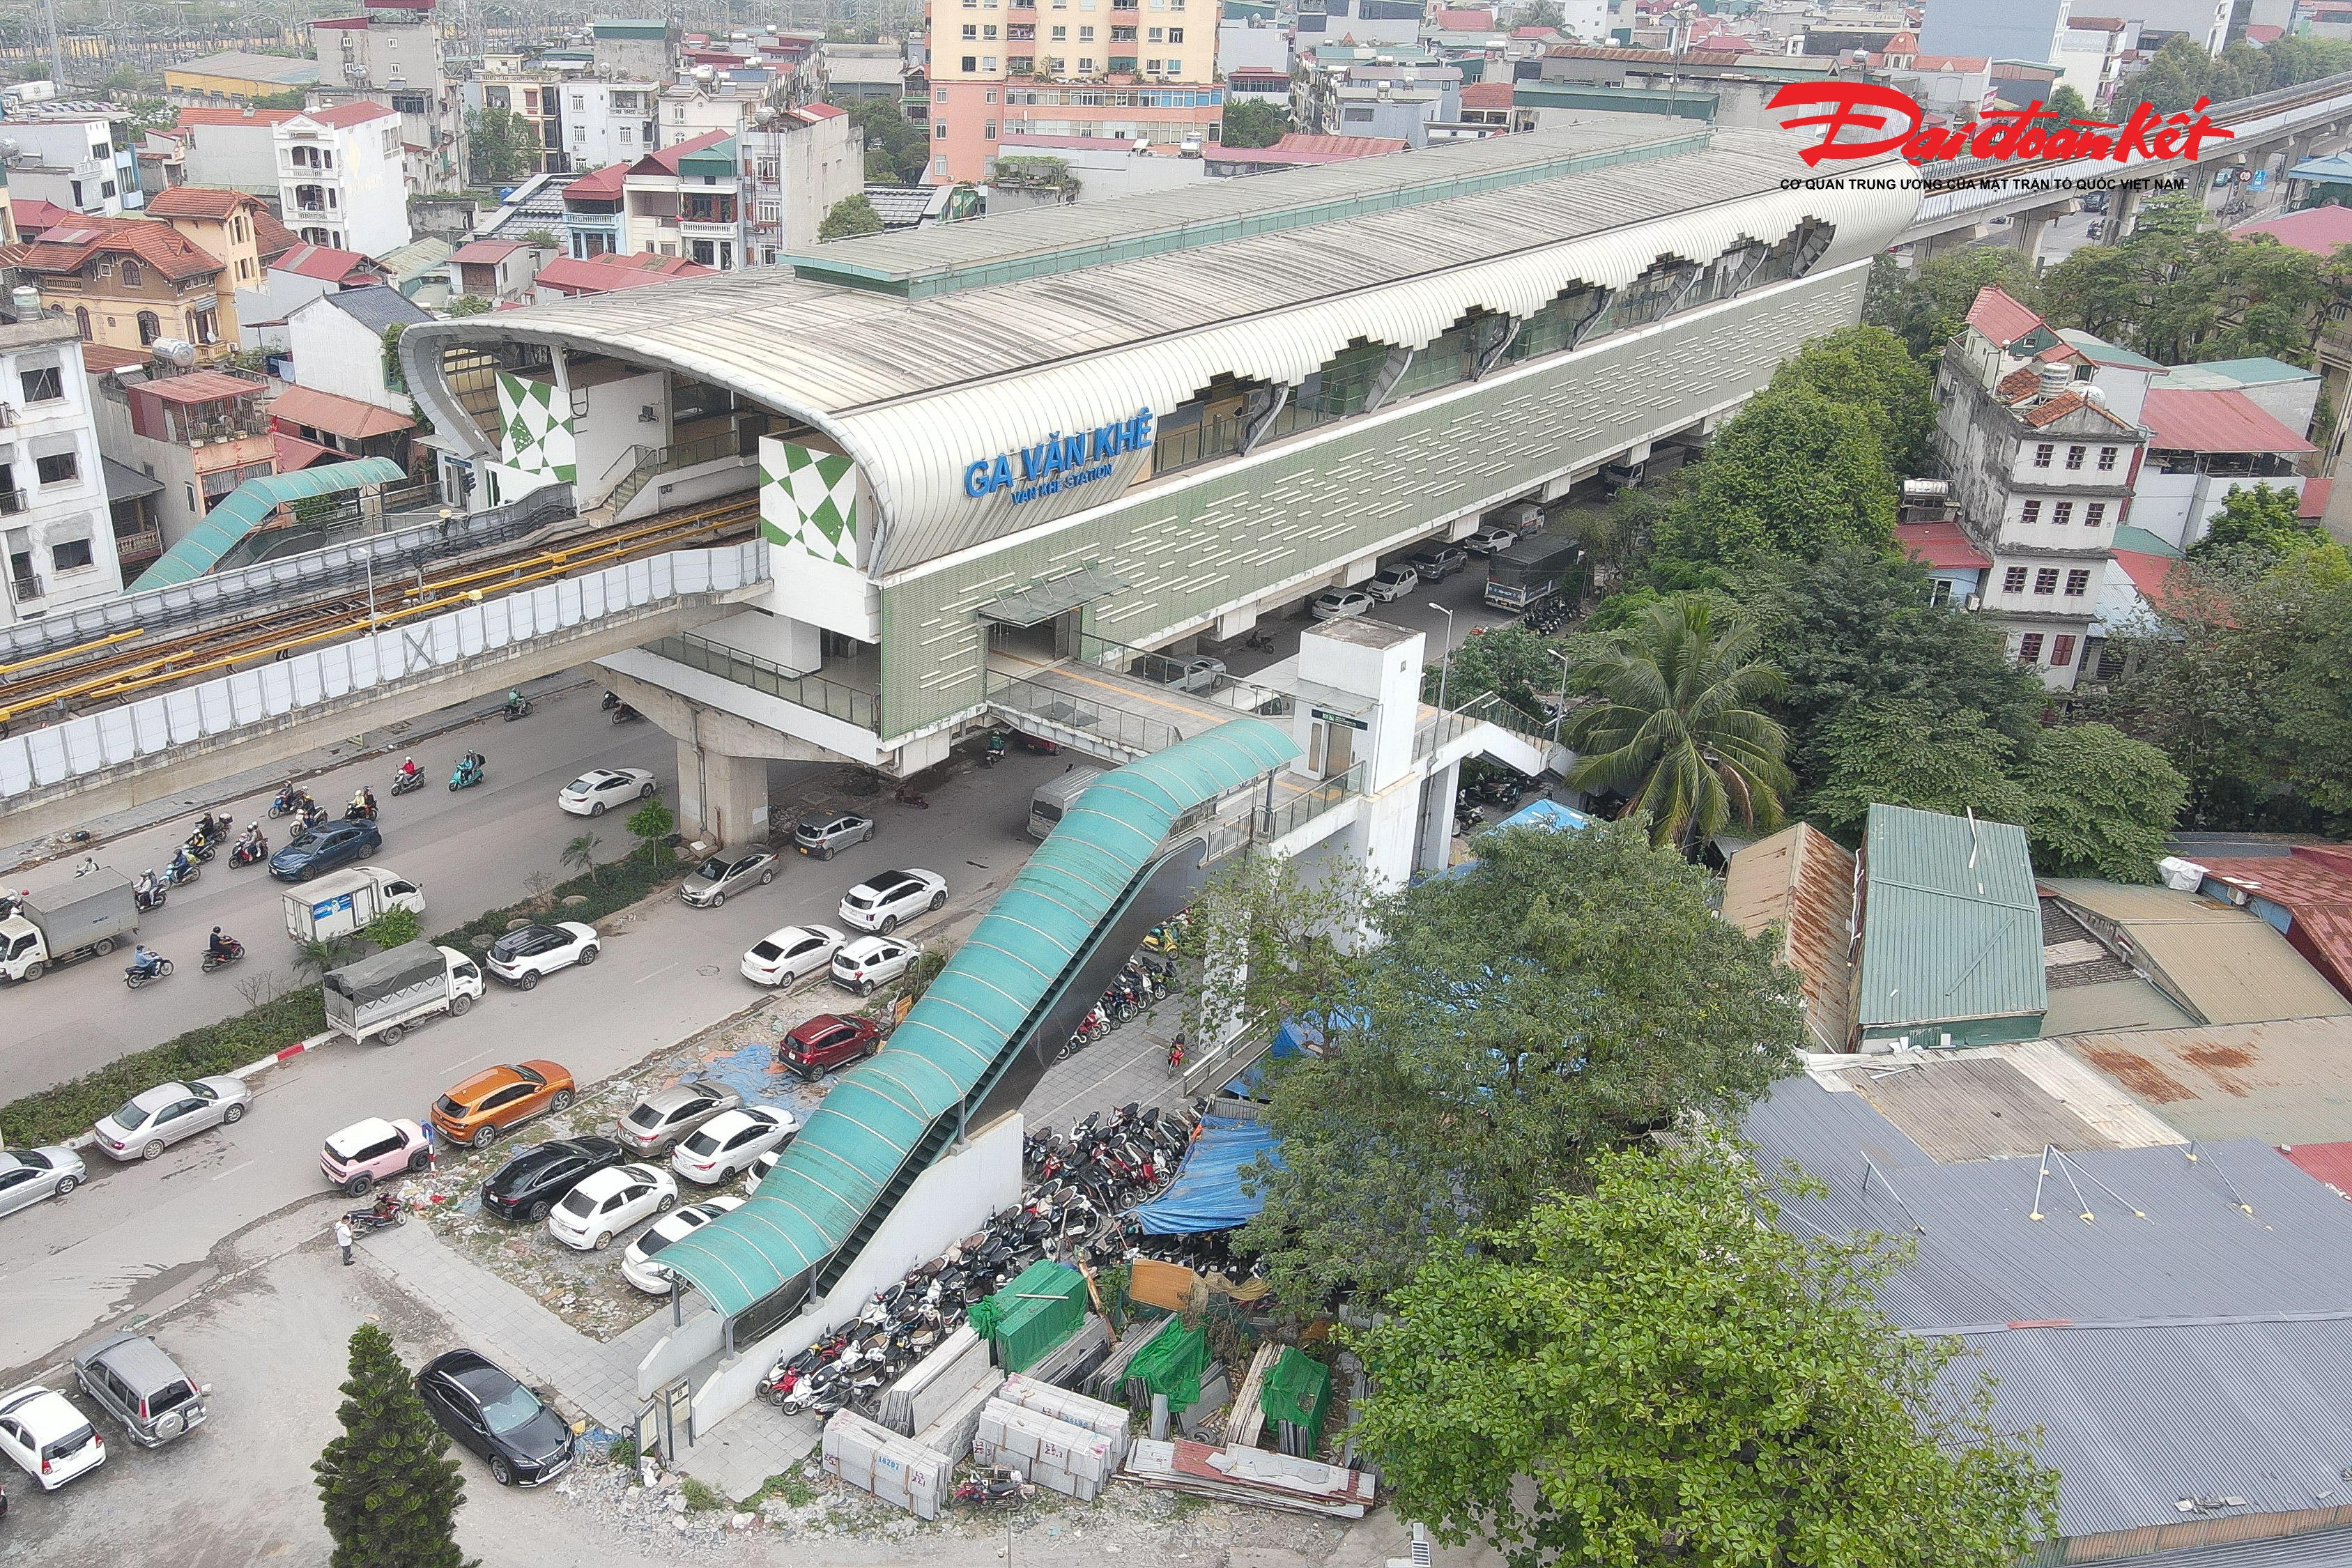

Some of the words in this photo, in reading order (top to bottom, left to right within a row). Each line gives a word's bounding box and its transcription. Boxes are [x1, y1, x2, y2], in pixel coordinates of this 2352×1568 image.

[964, 453, 1013, 498] GA
[1021, 430, 1086, 481] VĂN
[1010, 486, 1036, 505] VAN
[1038, 477, 1063, 496] KHE
[1065, 463, 1113, 489] STATION
